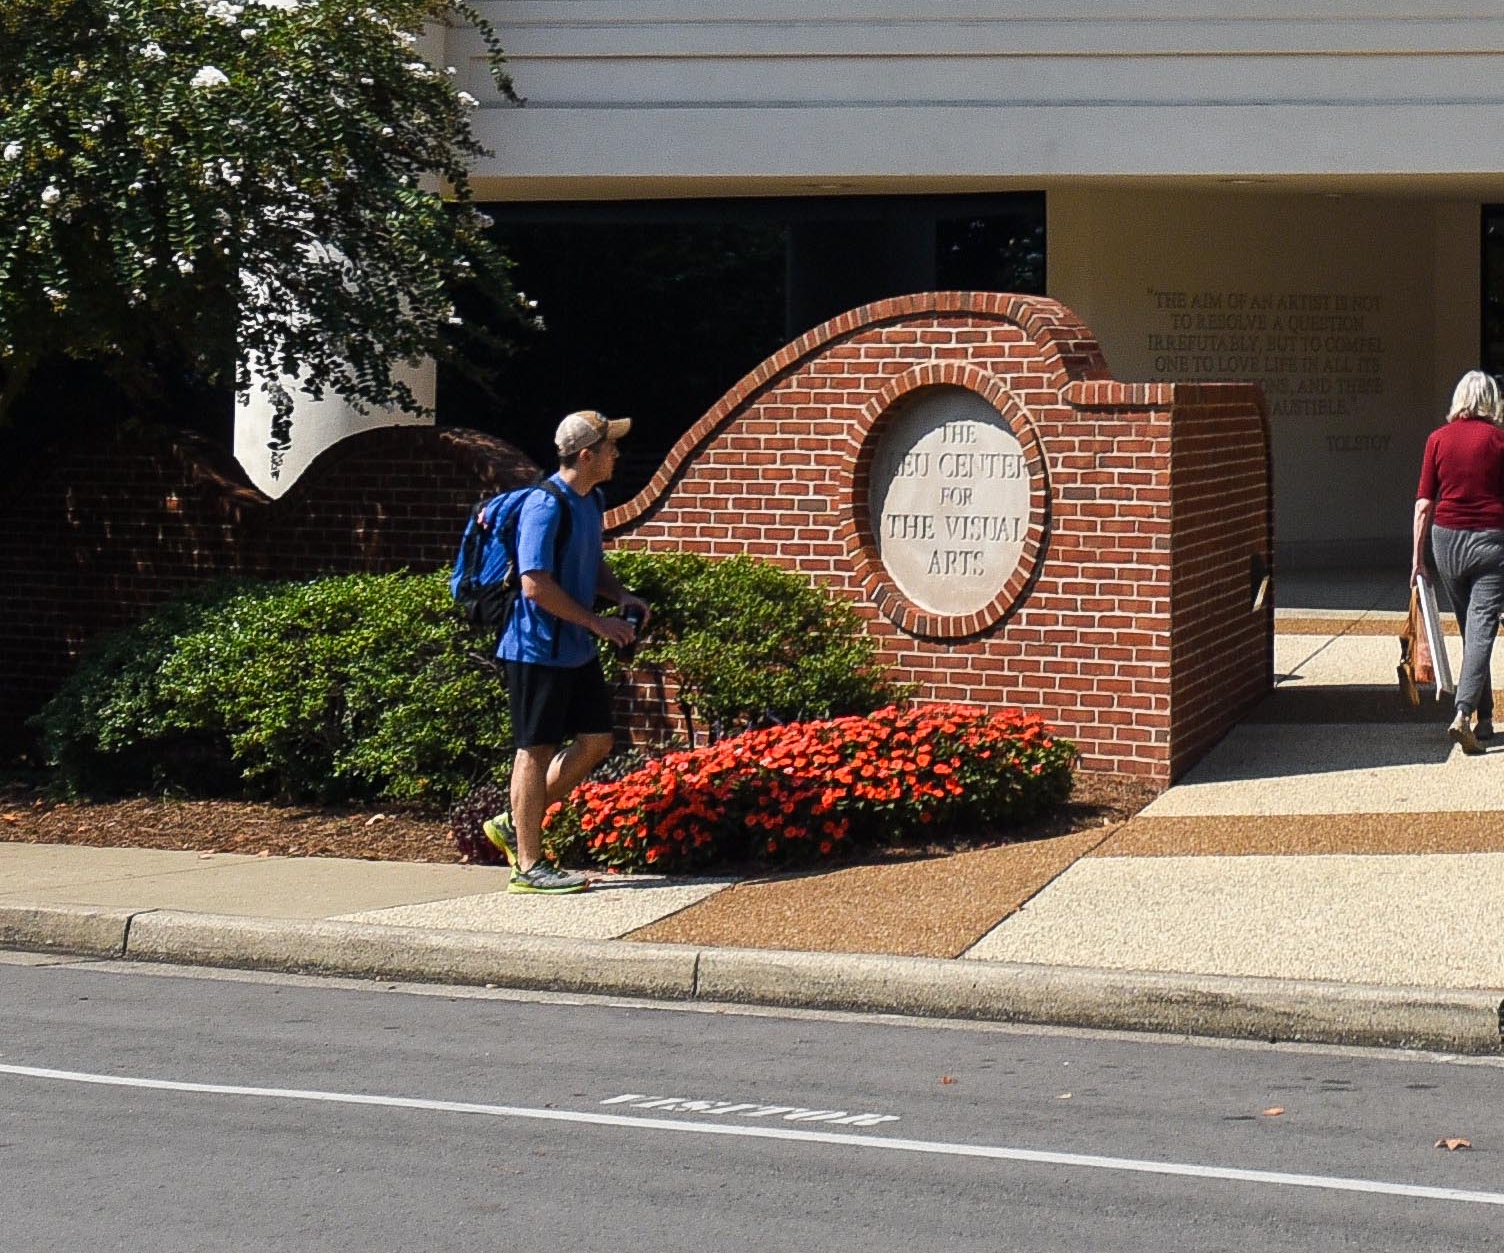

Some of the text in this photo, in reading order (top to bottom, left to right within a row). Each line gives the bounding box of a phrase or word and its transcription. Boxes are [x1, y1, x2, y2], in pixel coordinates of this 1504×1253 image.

[1190, 292, 1222, 309] AIM
[1227, 293, 1247, 310] OF
[1249, 294, 1273, 310] AN
[1275, 294, 1330, 311] ARTIST
[1352, 295, 1382, 312] NOT
[1170, 313, 1364, 334] TO RESOLVE A QUESTION
[1147, 334, 1385, 355] IRREFUTABLY, BUT TO COMPEL
[1154, 356, 1381, 373] ONE TO LOVE LIFE IN ALL ITS
[1296, 378, 1330, 394] AND
[939, 424, 978, 445] THE
[1325, 434, 1392, 452] TOLSTOY
[939, 486, 974, 507] FOR
[885, 513, 1027, 543] THE VISUAL
[927, 548, 986, 576] ARTS
